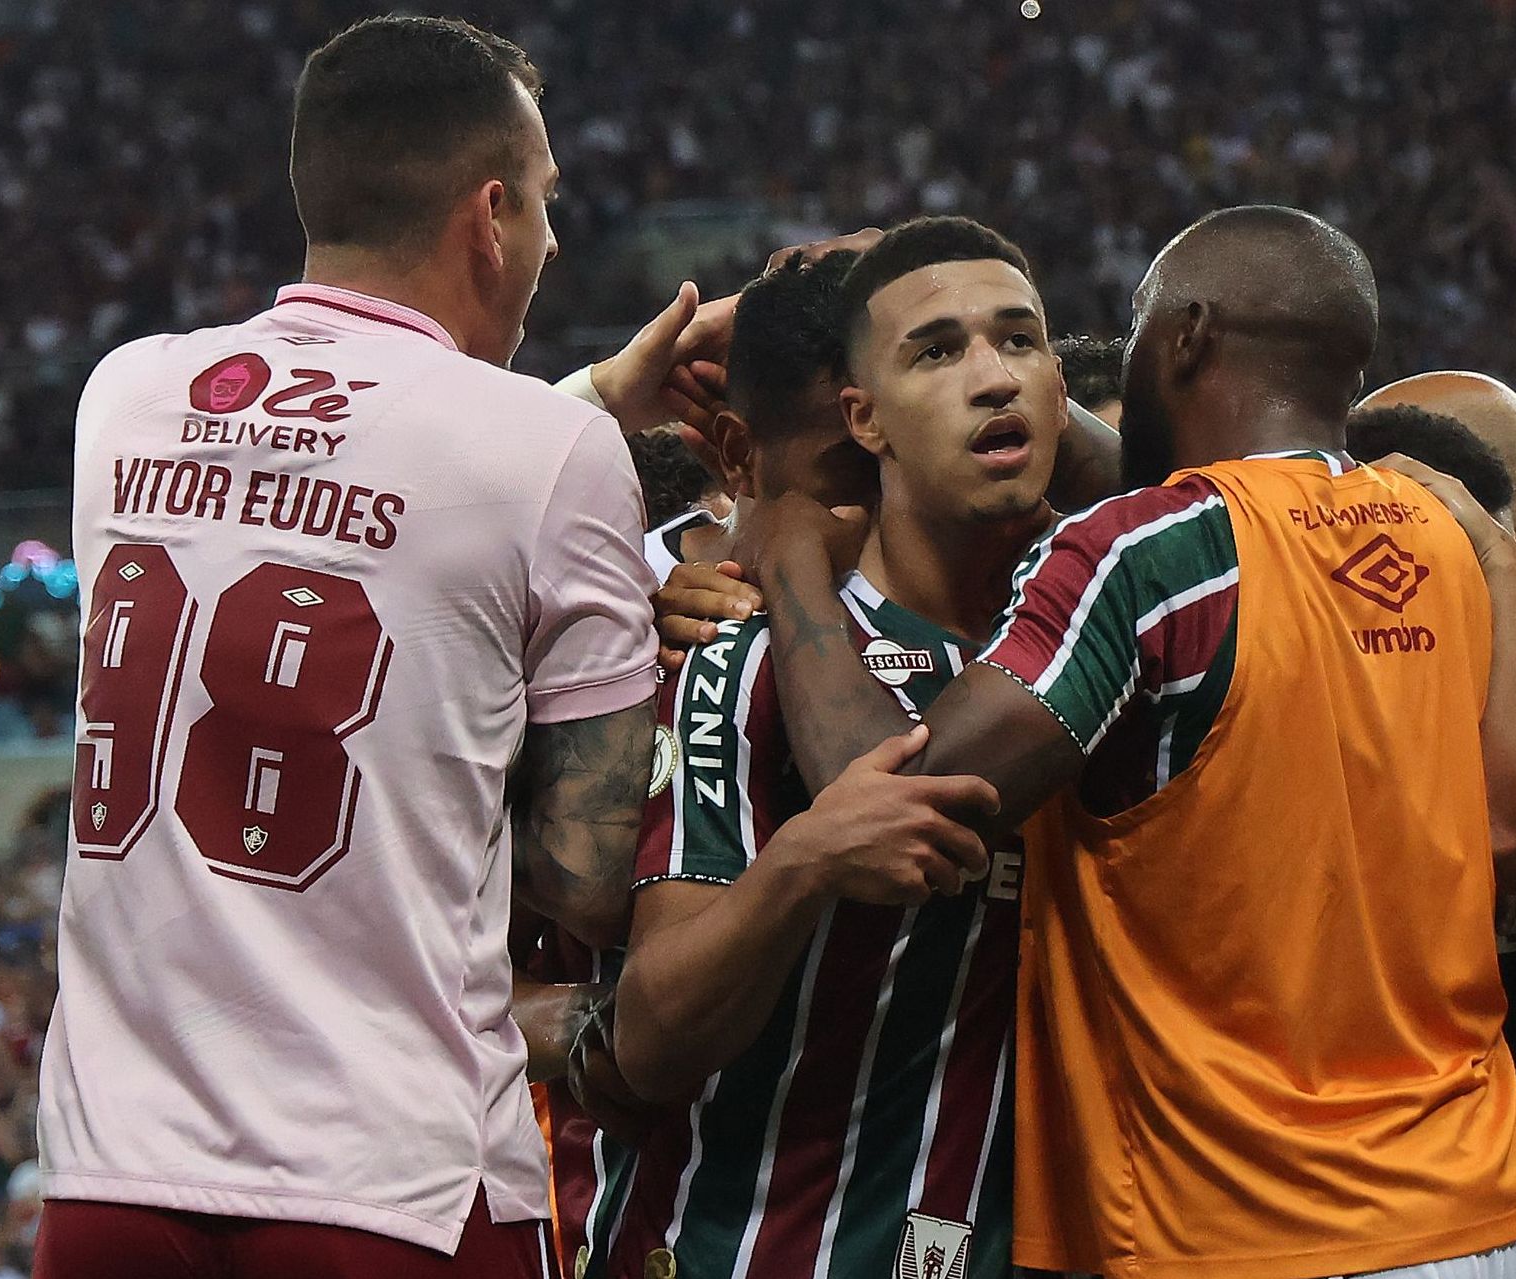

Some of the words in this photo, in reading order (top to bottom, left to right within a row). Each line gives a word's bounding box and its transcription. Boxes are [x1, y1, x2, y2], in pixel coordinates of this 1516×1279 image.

[181, 419, 346, 456] DELIVERY
[114, 457, 232, 521] VITOR
[239, 470, 405, 550] EUDES
[863, 655, 926, 670] ESCATTO
[72, 543, 394, 893] 98
